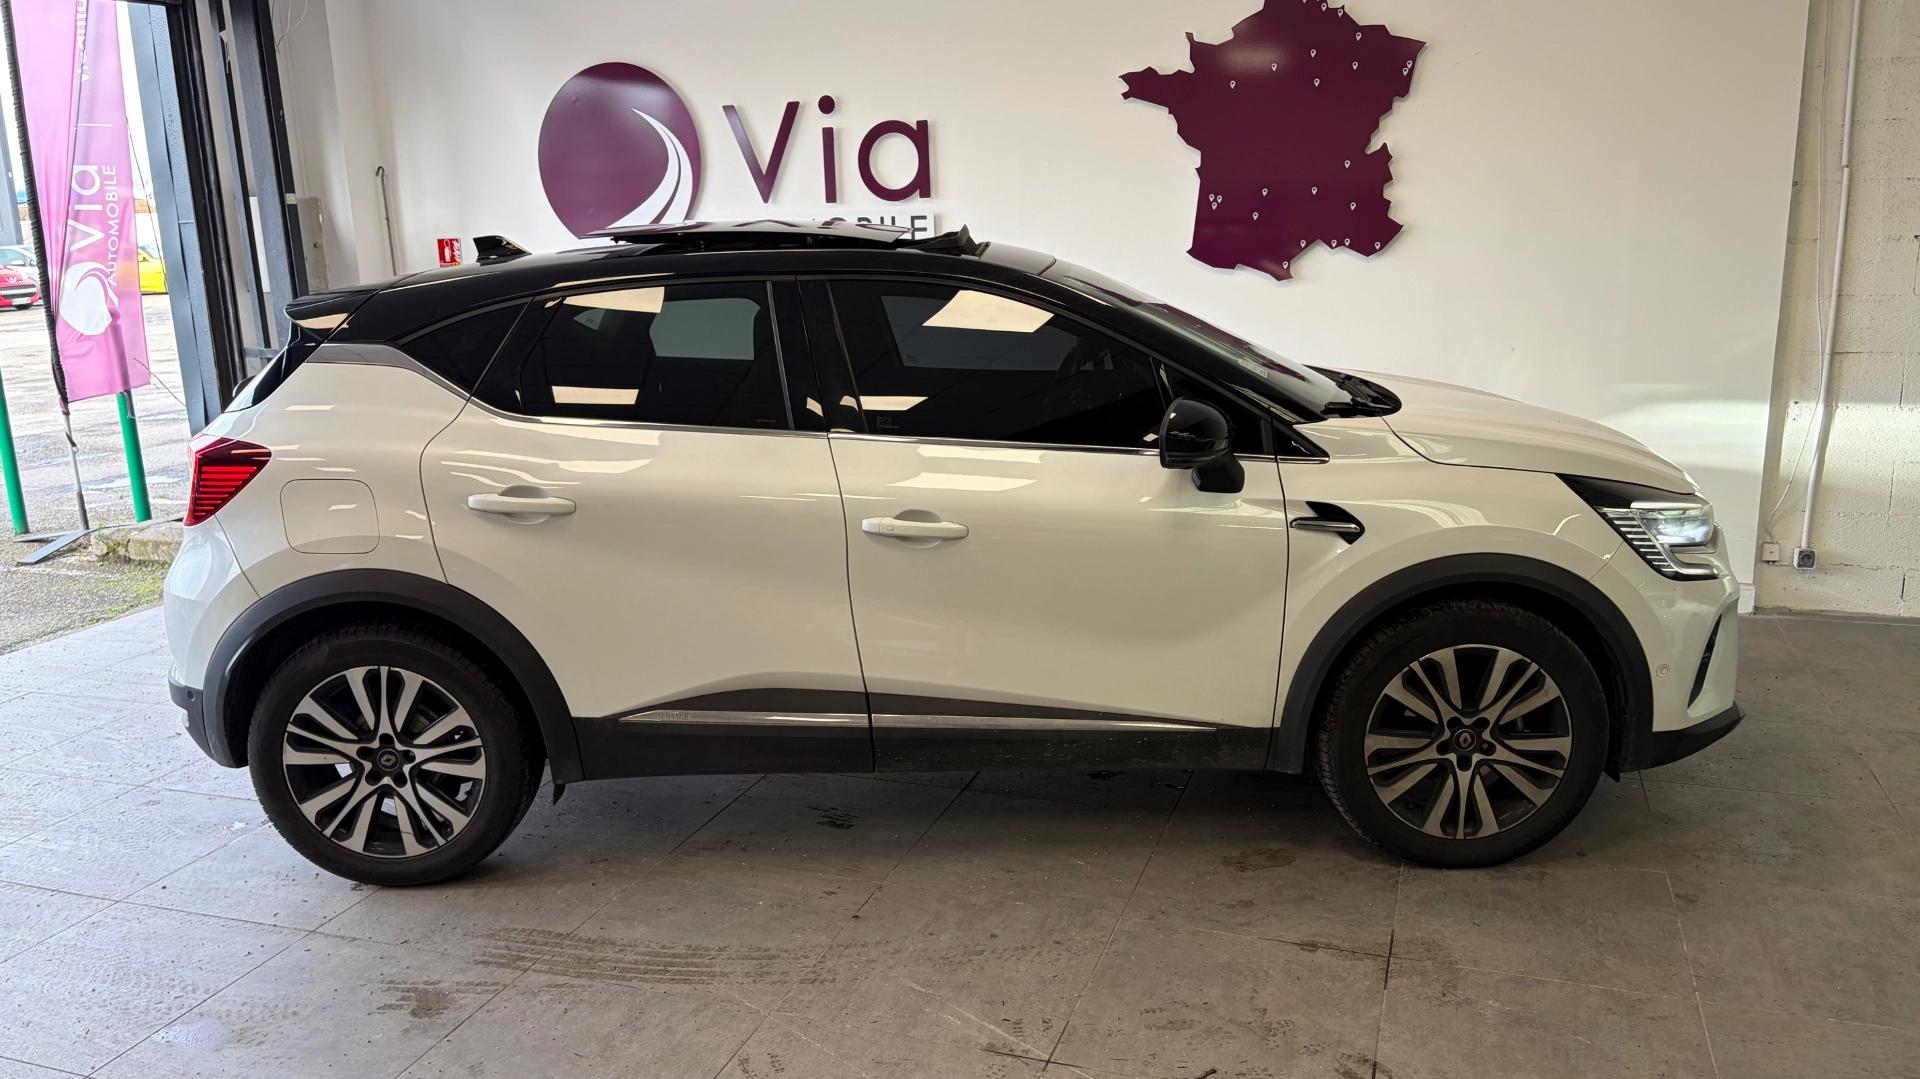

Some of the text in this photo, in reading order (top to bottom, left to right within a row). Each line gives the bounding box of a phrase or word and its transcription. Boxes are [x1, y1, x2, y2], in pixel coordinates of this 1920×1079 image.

[722, 95, 931, 203] Via
[67, 165, 104, 251] Via
[103, 165, 119, 286] AUTOMOBILE
